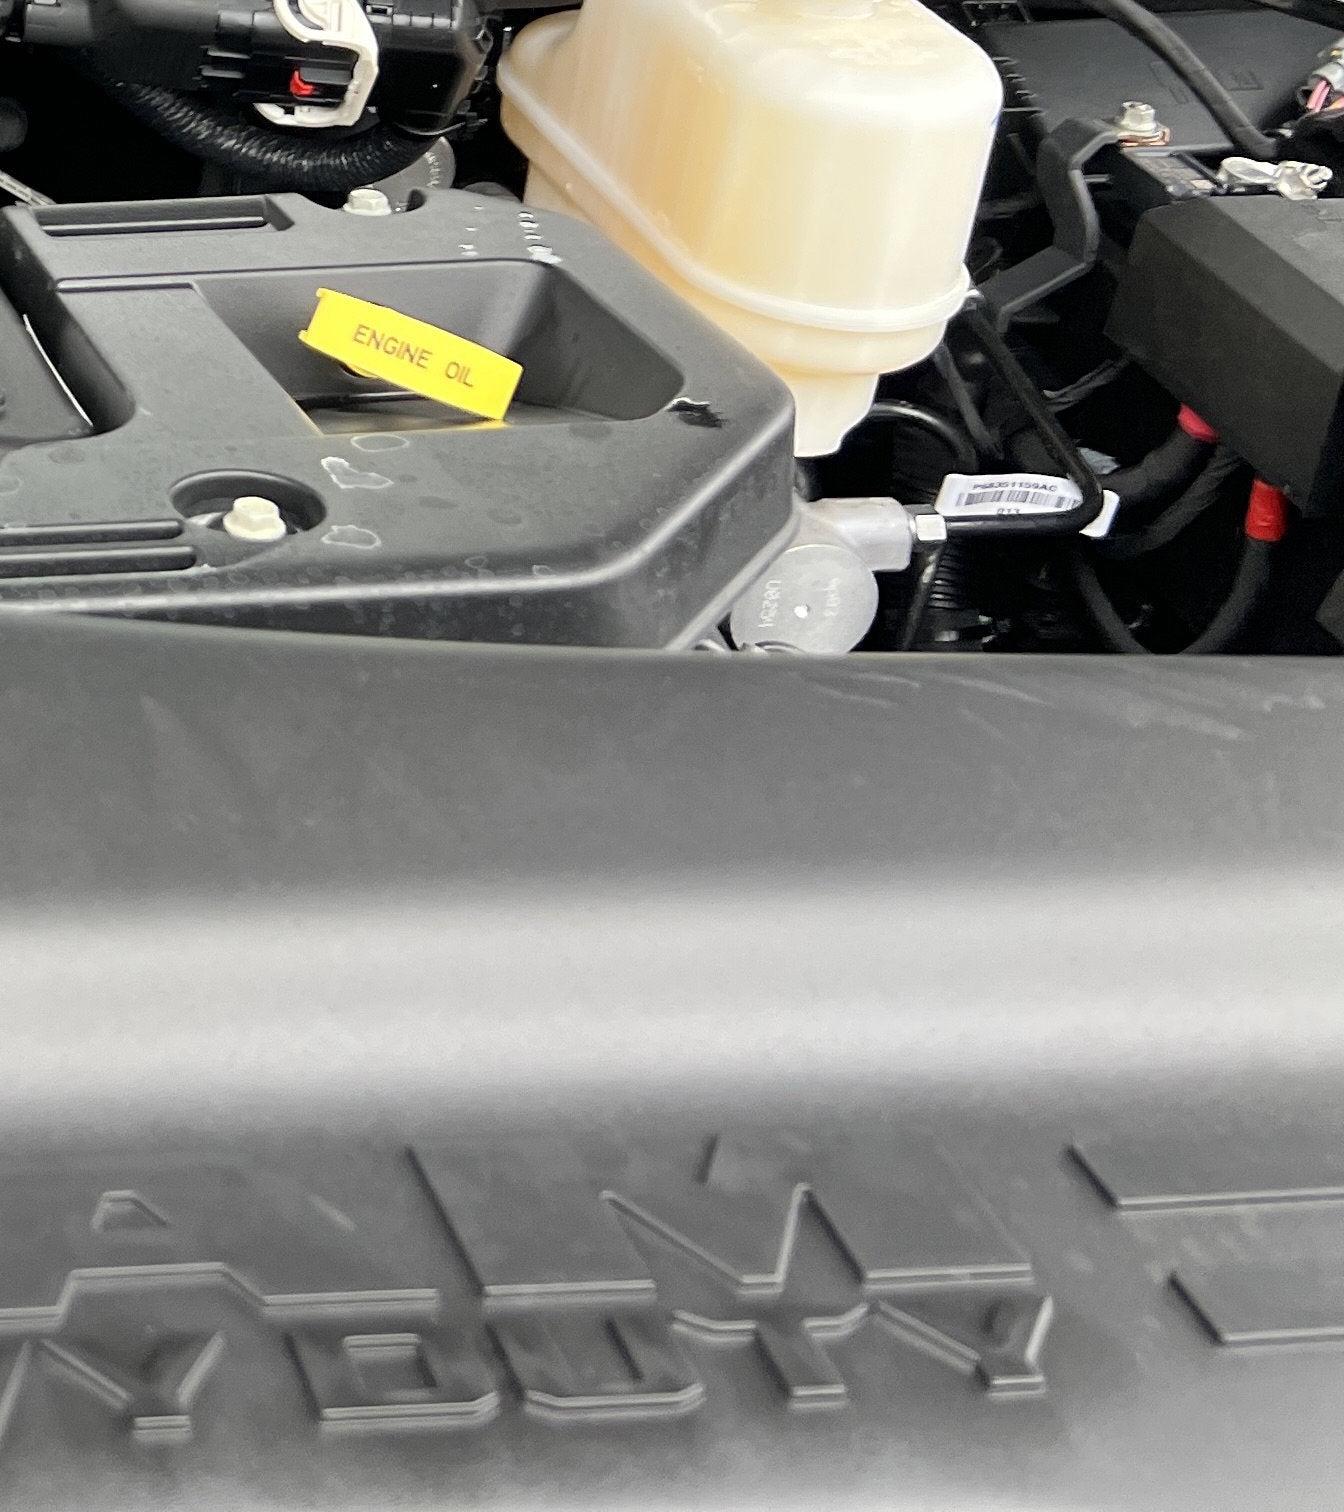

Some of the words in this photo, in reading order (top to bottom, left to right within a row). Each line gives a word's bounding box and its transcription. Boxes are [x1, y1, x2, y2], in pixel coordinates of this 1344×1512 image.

[353, 325, 433, 369] ENGINE
[445, 362, 474, 387] OIL
[284, 1295, 1053, 1428] DUTY
